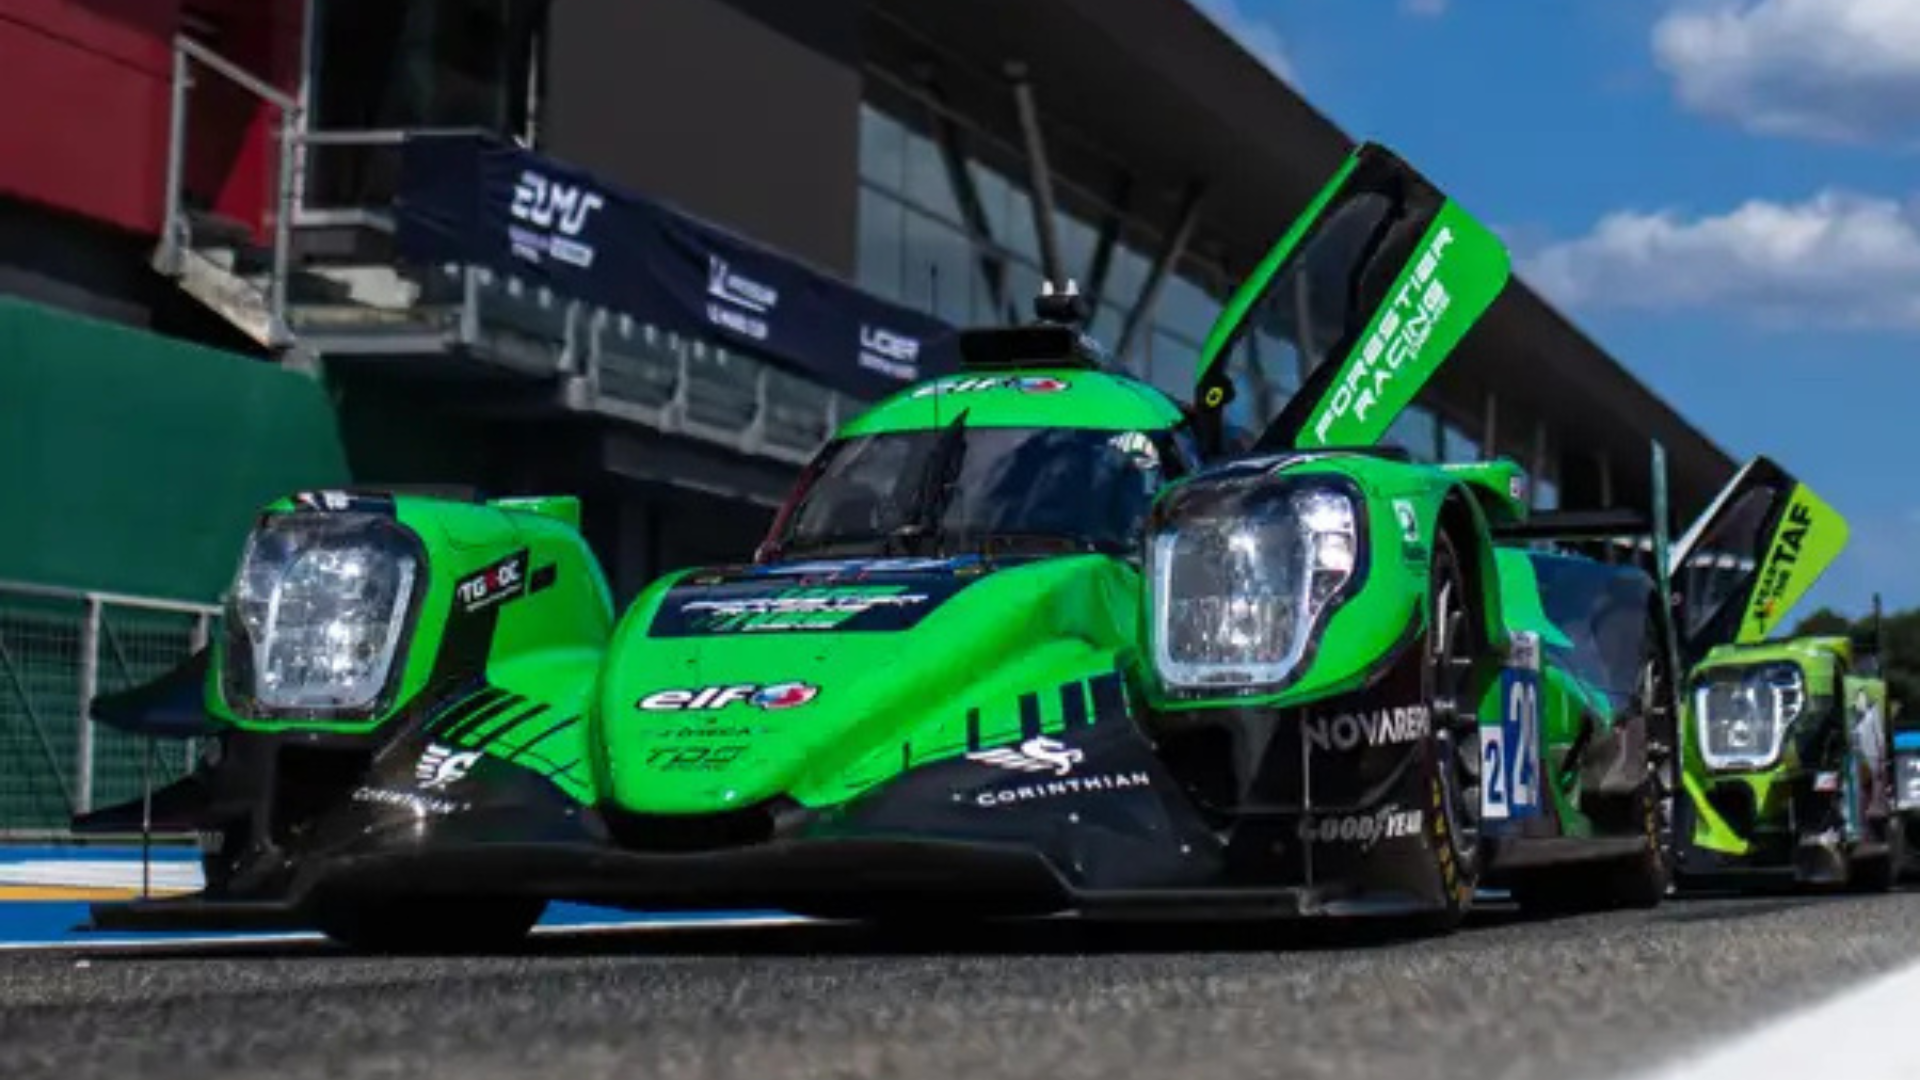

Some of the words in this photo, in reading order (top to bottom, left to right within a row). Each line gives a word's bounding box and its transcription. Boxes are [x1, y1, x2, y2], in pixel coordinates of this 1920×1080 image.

[1314, 226, 1454, 445] FORESTIER
[1353, 278, 1447, 423] RACING
[1773, 502, 1813, 566] TAF
[977, 771, 1151, 807] CORINTHIAN
